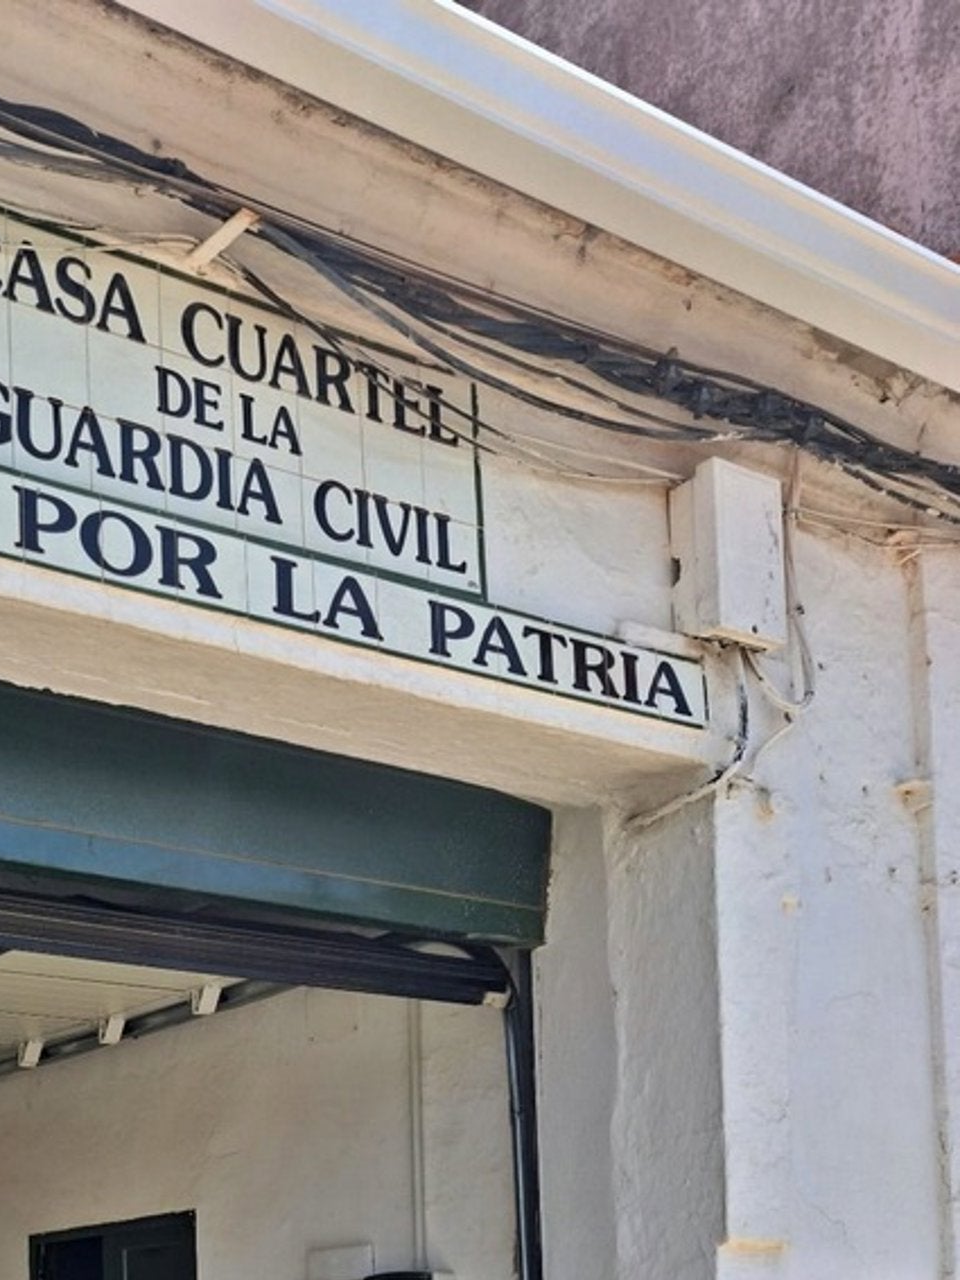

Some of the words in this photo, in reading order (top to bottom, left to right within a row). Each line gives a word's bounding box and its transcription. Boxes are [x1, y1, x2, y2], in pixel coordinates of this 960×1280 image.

[155, 366, 224, 431] DE
[239, 393, 303, 456] LA
[181, 301, 459, 448] CUARTEL
[313, 479, 467, 574] CIVIL
[12, 484, 222, 600] POR
[269, 555, 384, 642] LA
[428, 599, 693, 717] PATRIA
